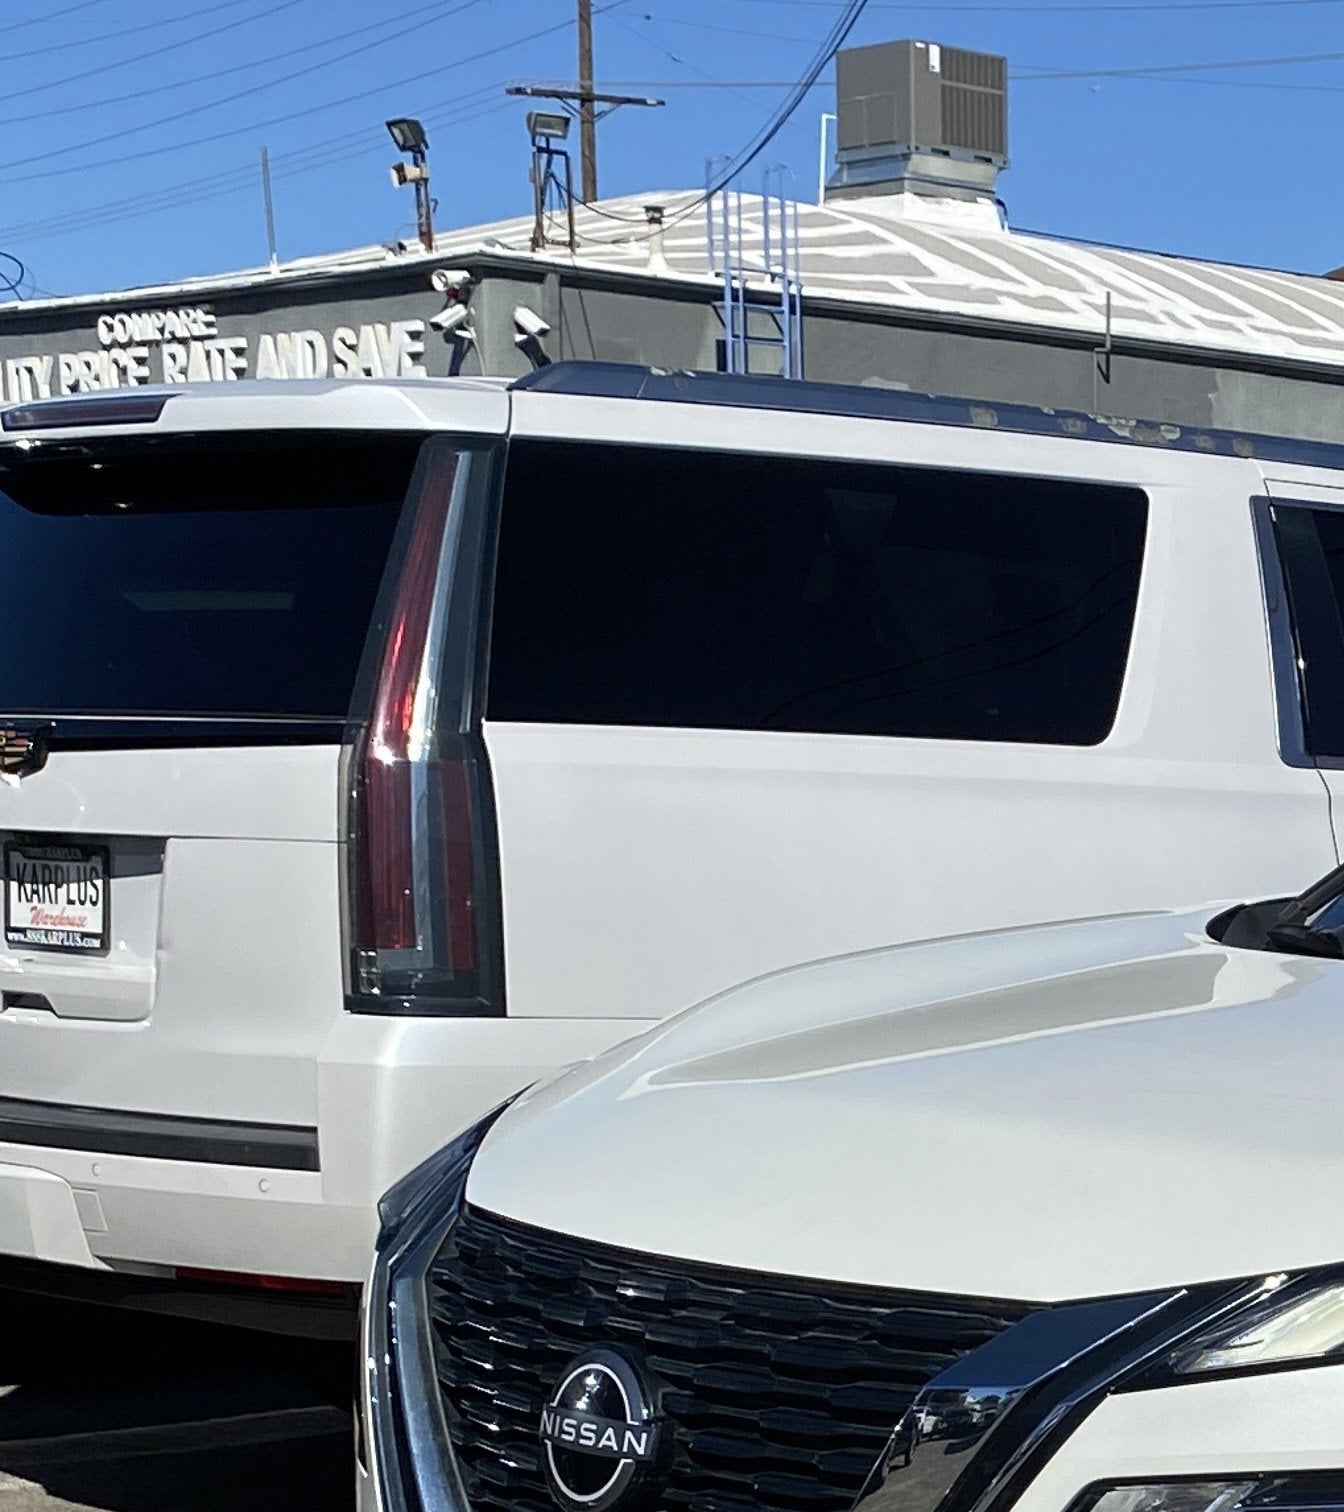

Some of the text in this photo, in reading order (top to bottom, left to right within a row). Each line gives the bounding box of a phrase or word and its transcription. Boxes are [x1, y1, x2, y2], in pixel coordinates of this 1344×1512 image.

[97, 309, 219, 345] COMPARE
[0, 319, 427, 402] ITY PRICE RATE AND SAVE
[16, 862, 101, 907] KARPLUS
[539, 1409, 648, 1456] NISSAN
